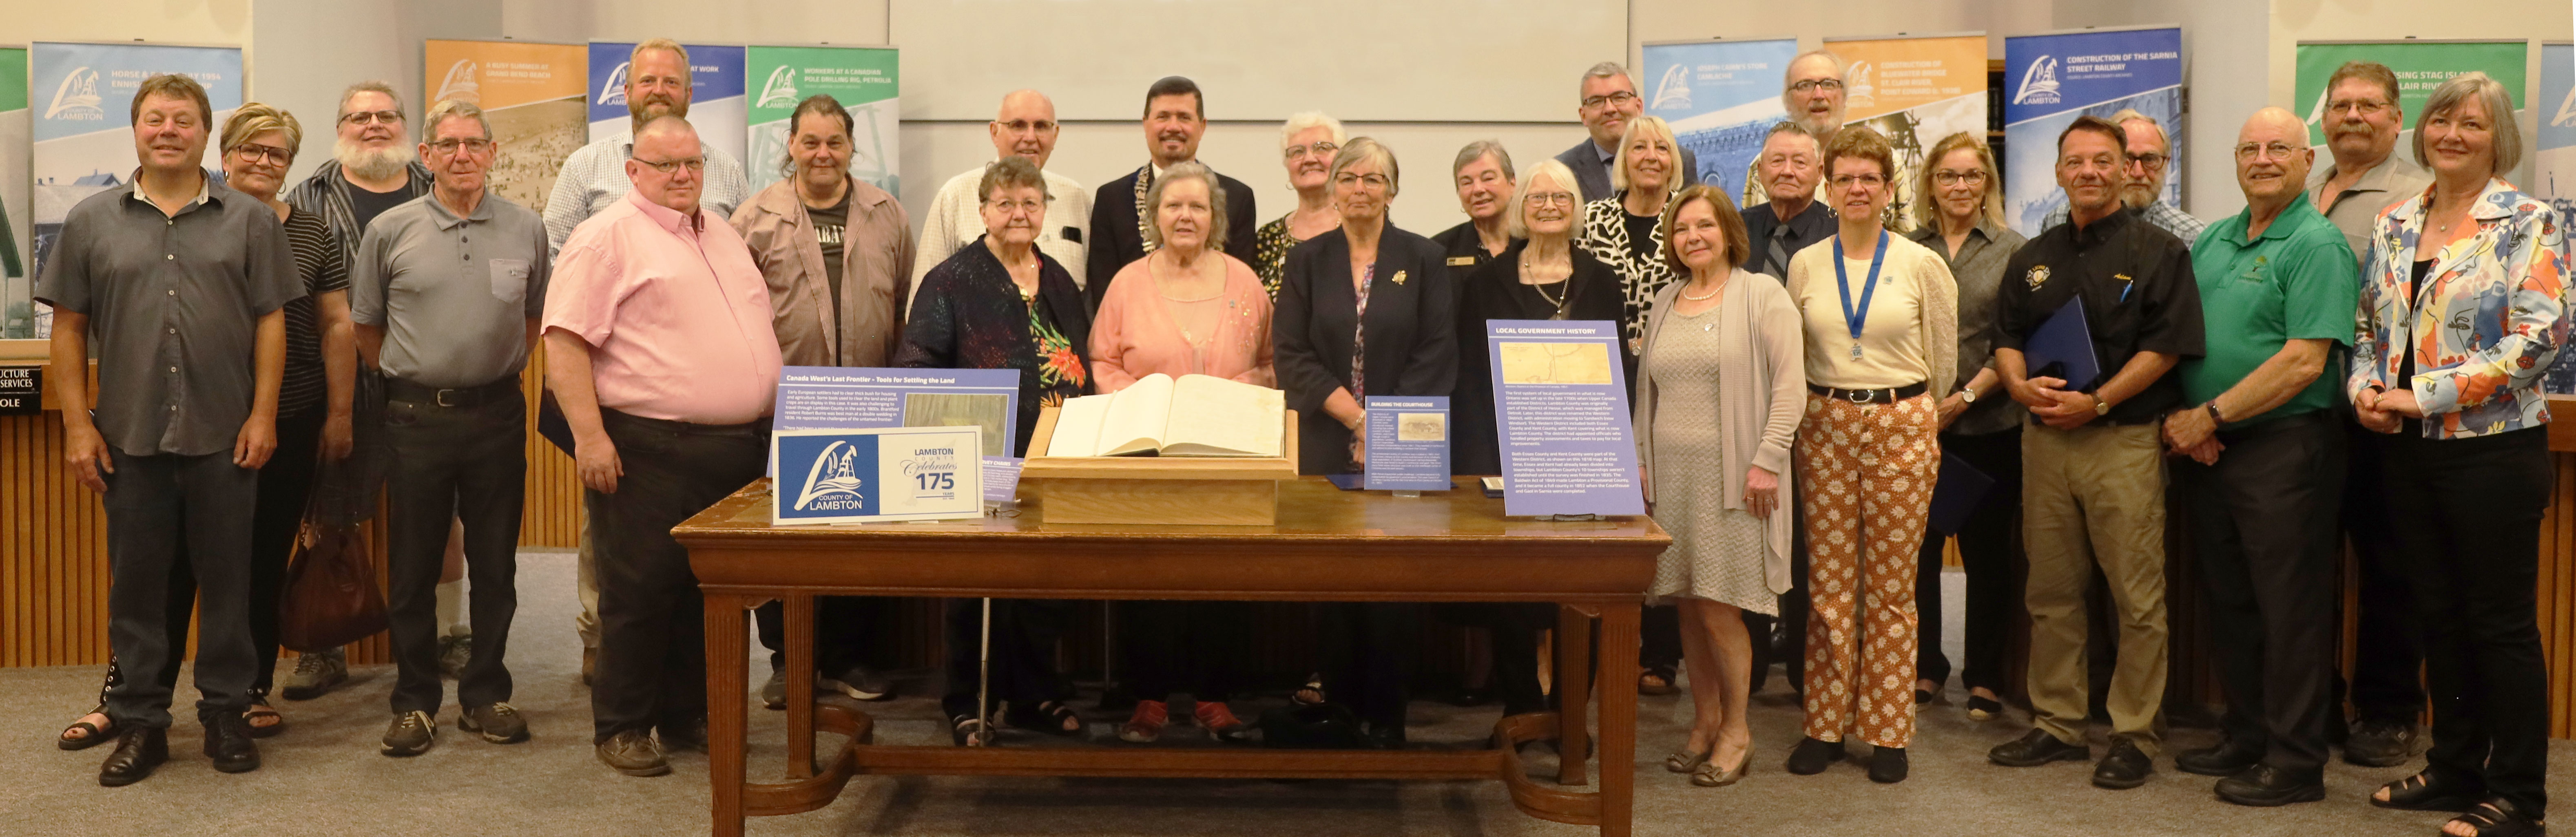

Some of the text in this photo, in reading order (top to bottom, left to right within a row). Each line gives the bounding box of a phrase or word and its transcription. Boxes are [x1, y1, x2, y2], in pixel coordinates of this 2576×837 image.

[2149, 51, 2178, 60] SARNIA
[2094, 63, 2126, 71] RAILWAY
[0, 379, 33, 388] SERVICES
[900, 459, 957, 477] Celebrates
[916, 473, 954, 490] 175
[810, 500, 862, 510] LAMBTON
